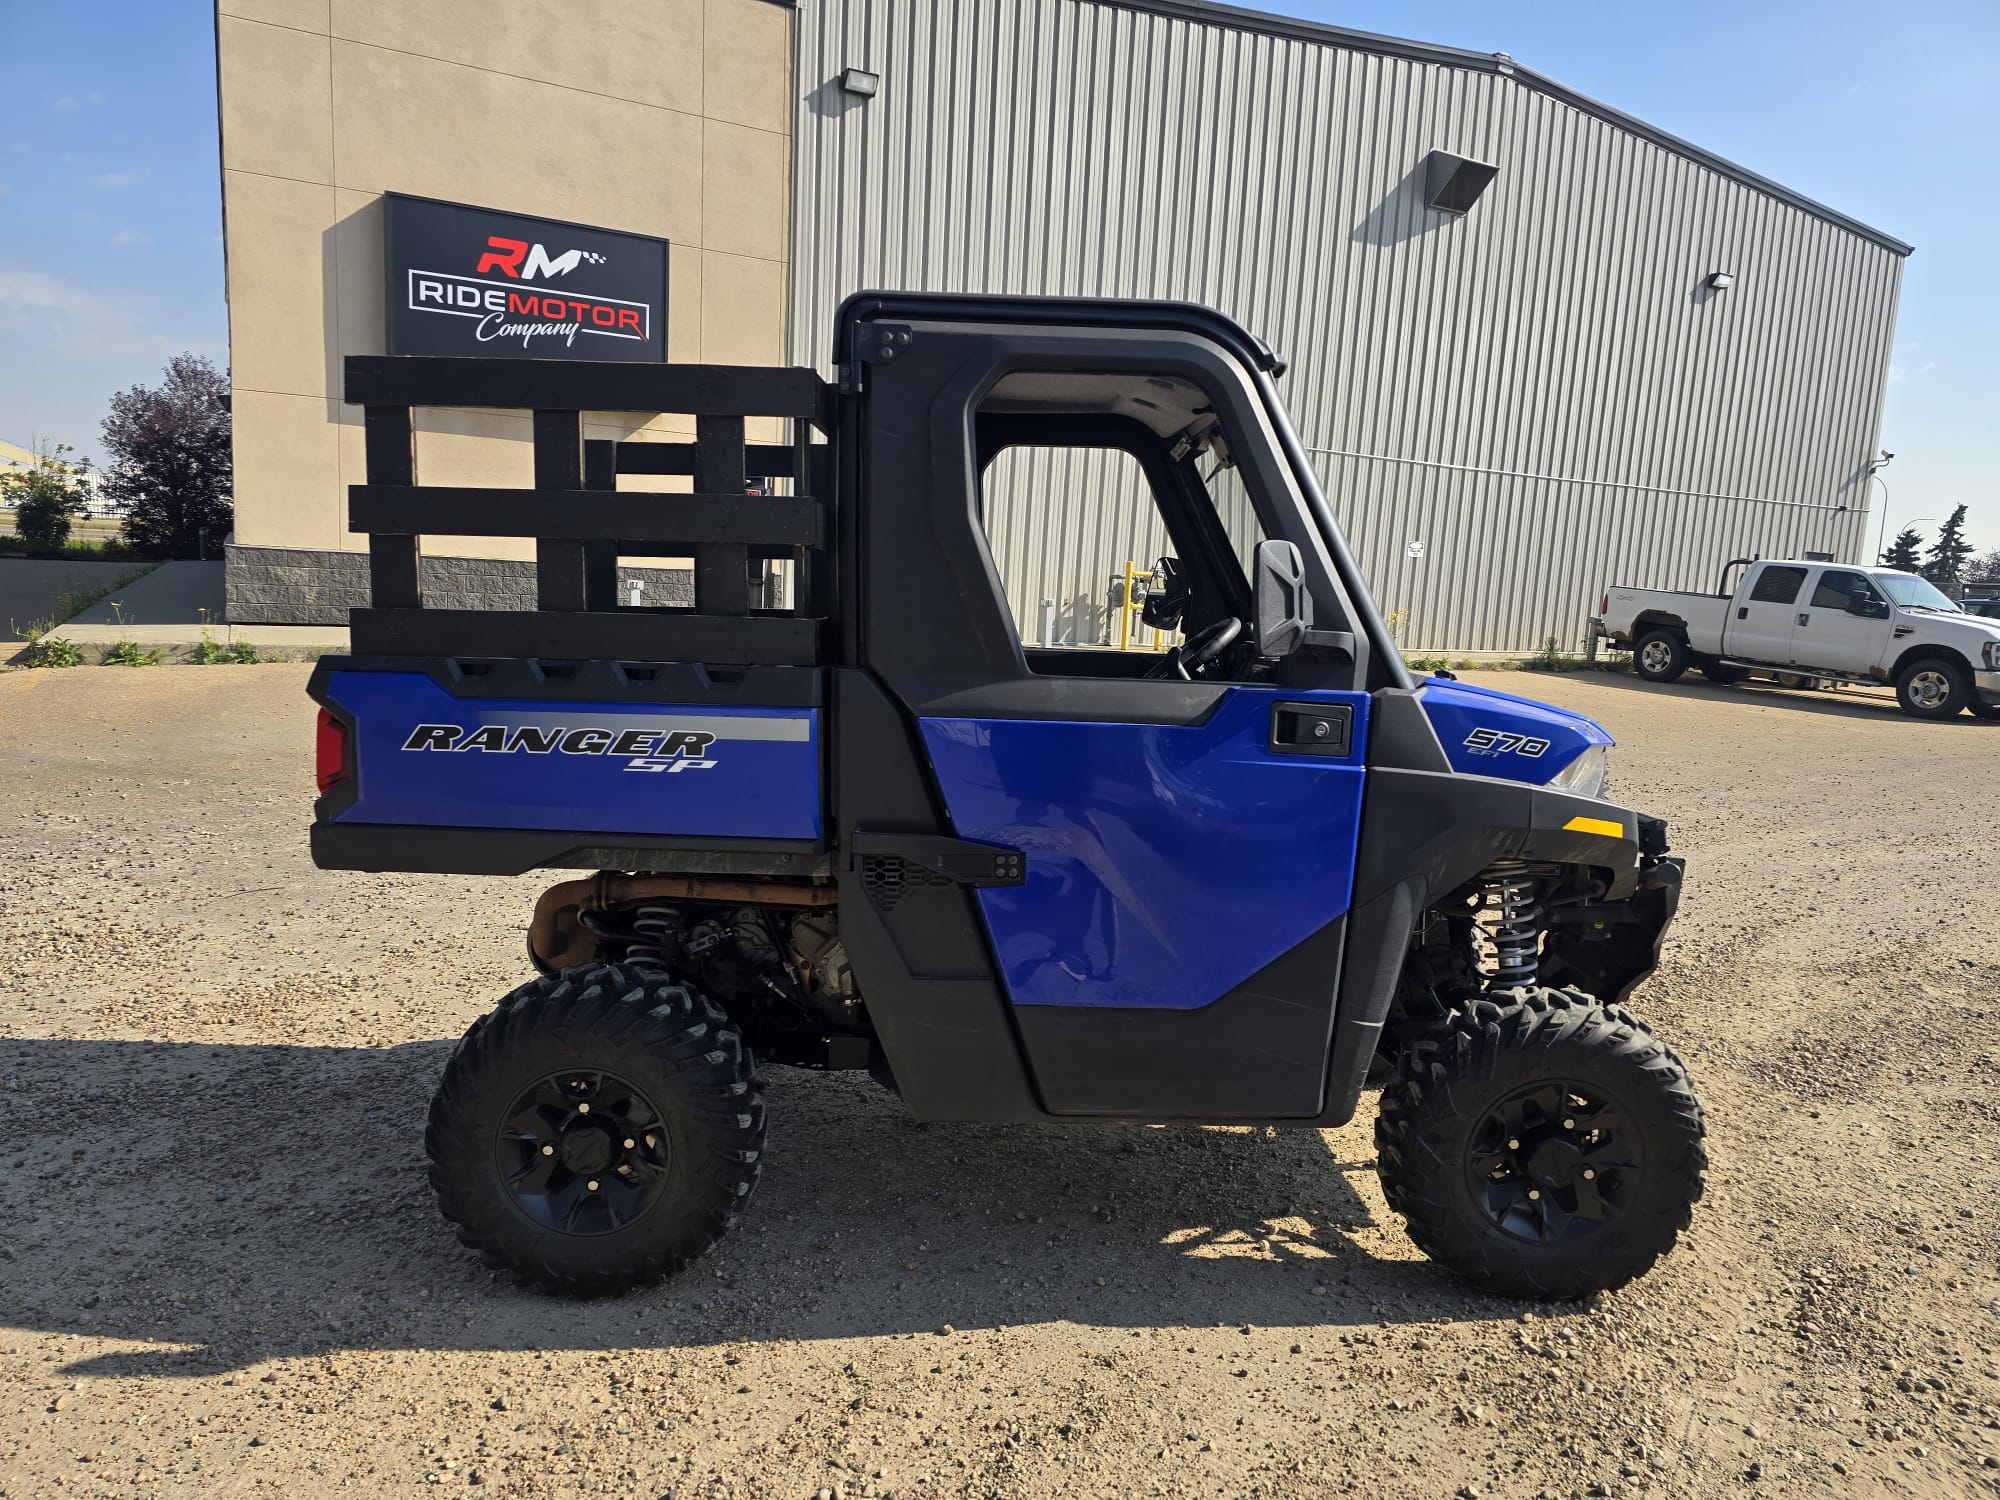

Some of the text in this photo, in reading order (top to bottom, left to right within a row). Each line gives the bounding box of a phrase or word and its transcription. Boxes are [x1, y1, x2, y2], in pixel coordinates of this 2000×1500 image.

[476, 235, 582, 280] RM
[475, 312, 580, 348] Company
[401, 724, 717, 757] RANGER
[1462, 727, 1551, 758] 570
[623, 758, 718, 773] SP
